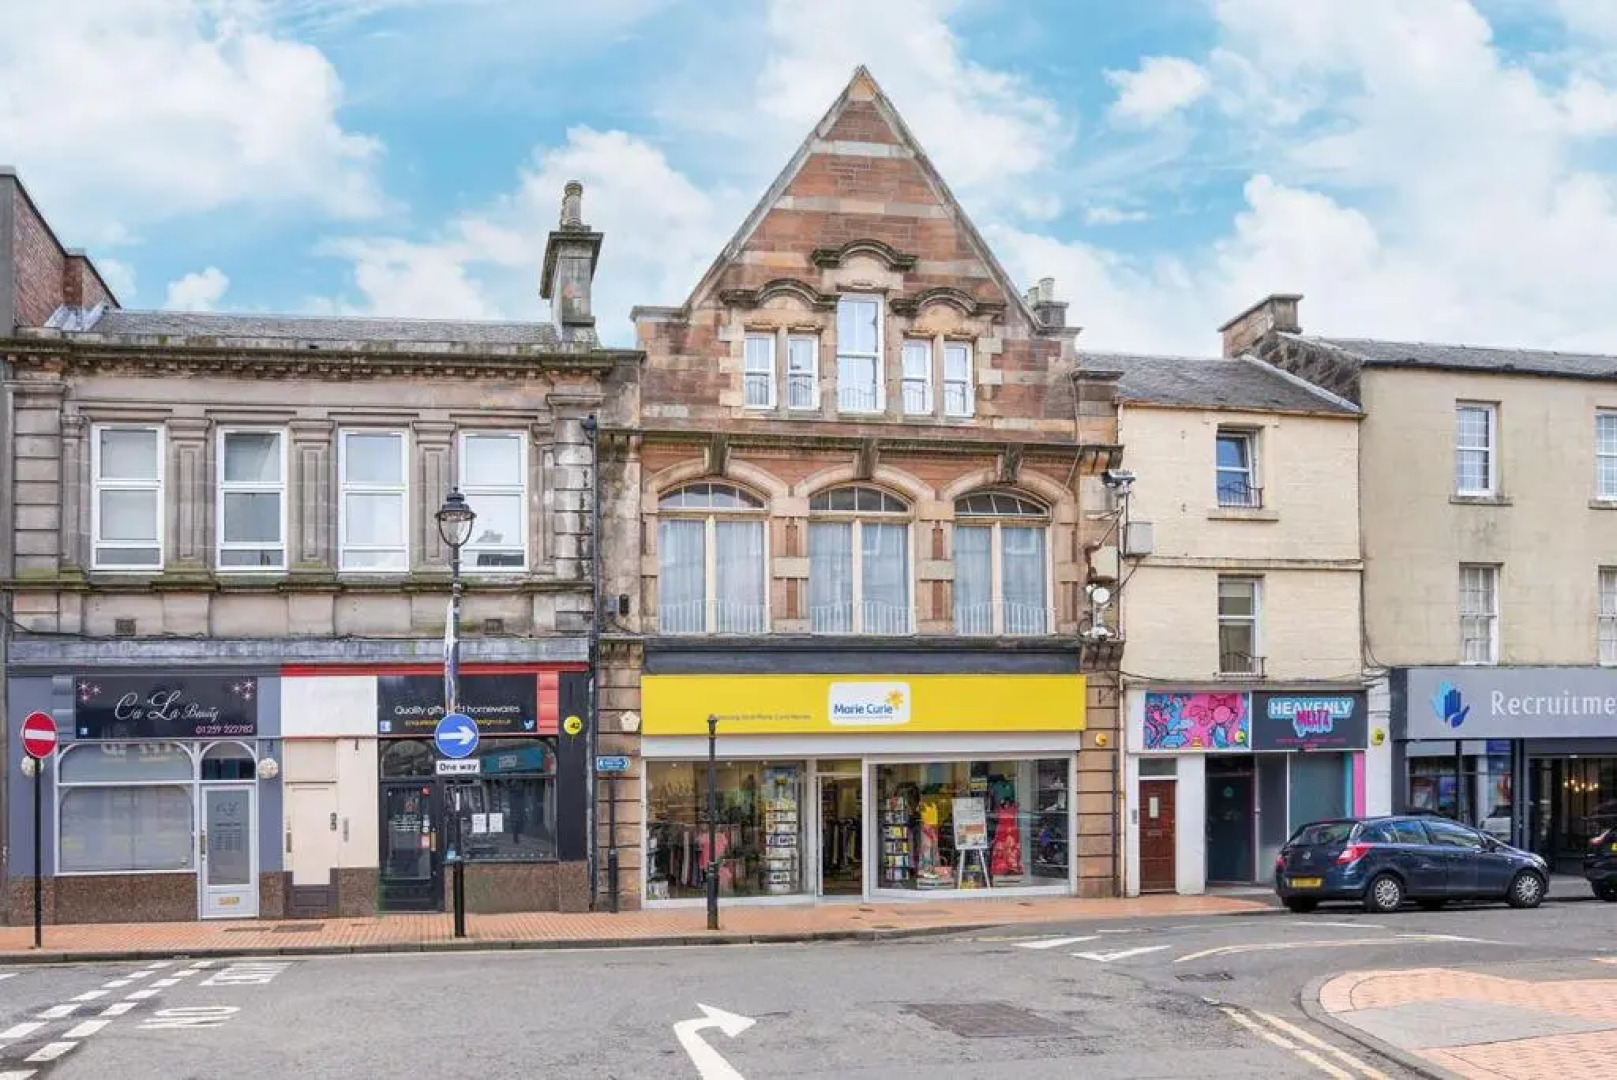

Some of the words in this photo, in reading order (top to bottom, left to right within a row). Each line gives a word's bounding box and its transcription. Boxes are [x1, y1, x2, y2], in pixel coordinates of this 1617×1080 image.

[833, 703, 864, 714] Marie
[866, 703, 893, 714] Curie
[1270, 700, 1352, 715] HEAVENLY
[1491, 690, 1617, 715] Recruitme
[182, 706, 220, 722] Beauty
[394, 705, 426, 715] Quality
[428, 705, 444, 715] gifts
[467, 704, 521, 714] homewares
[438, 763, 457, 771] One
[459, 763, 478, 772] way
